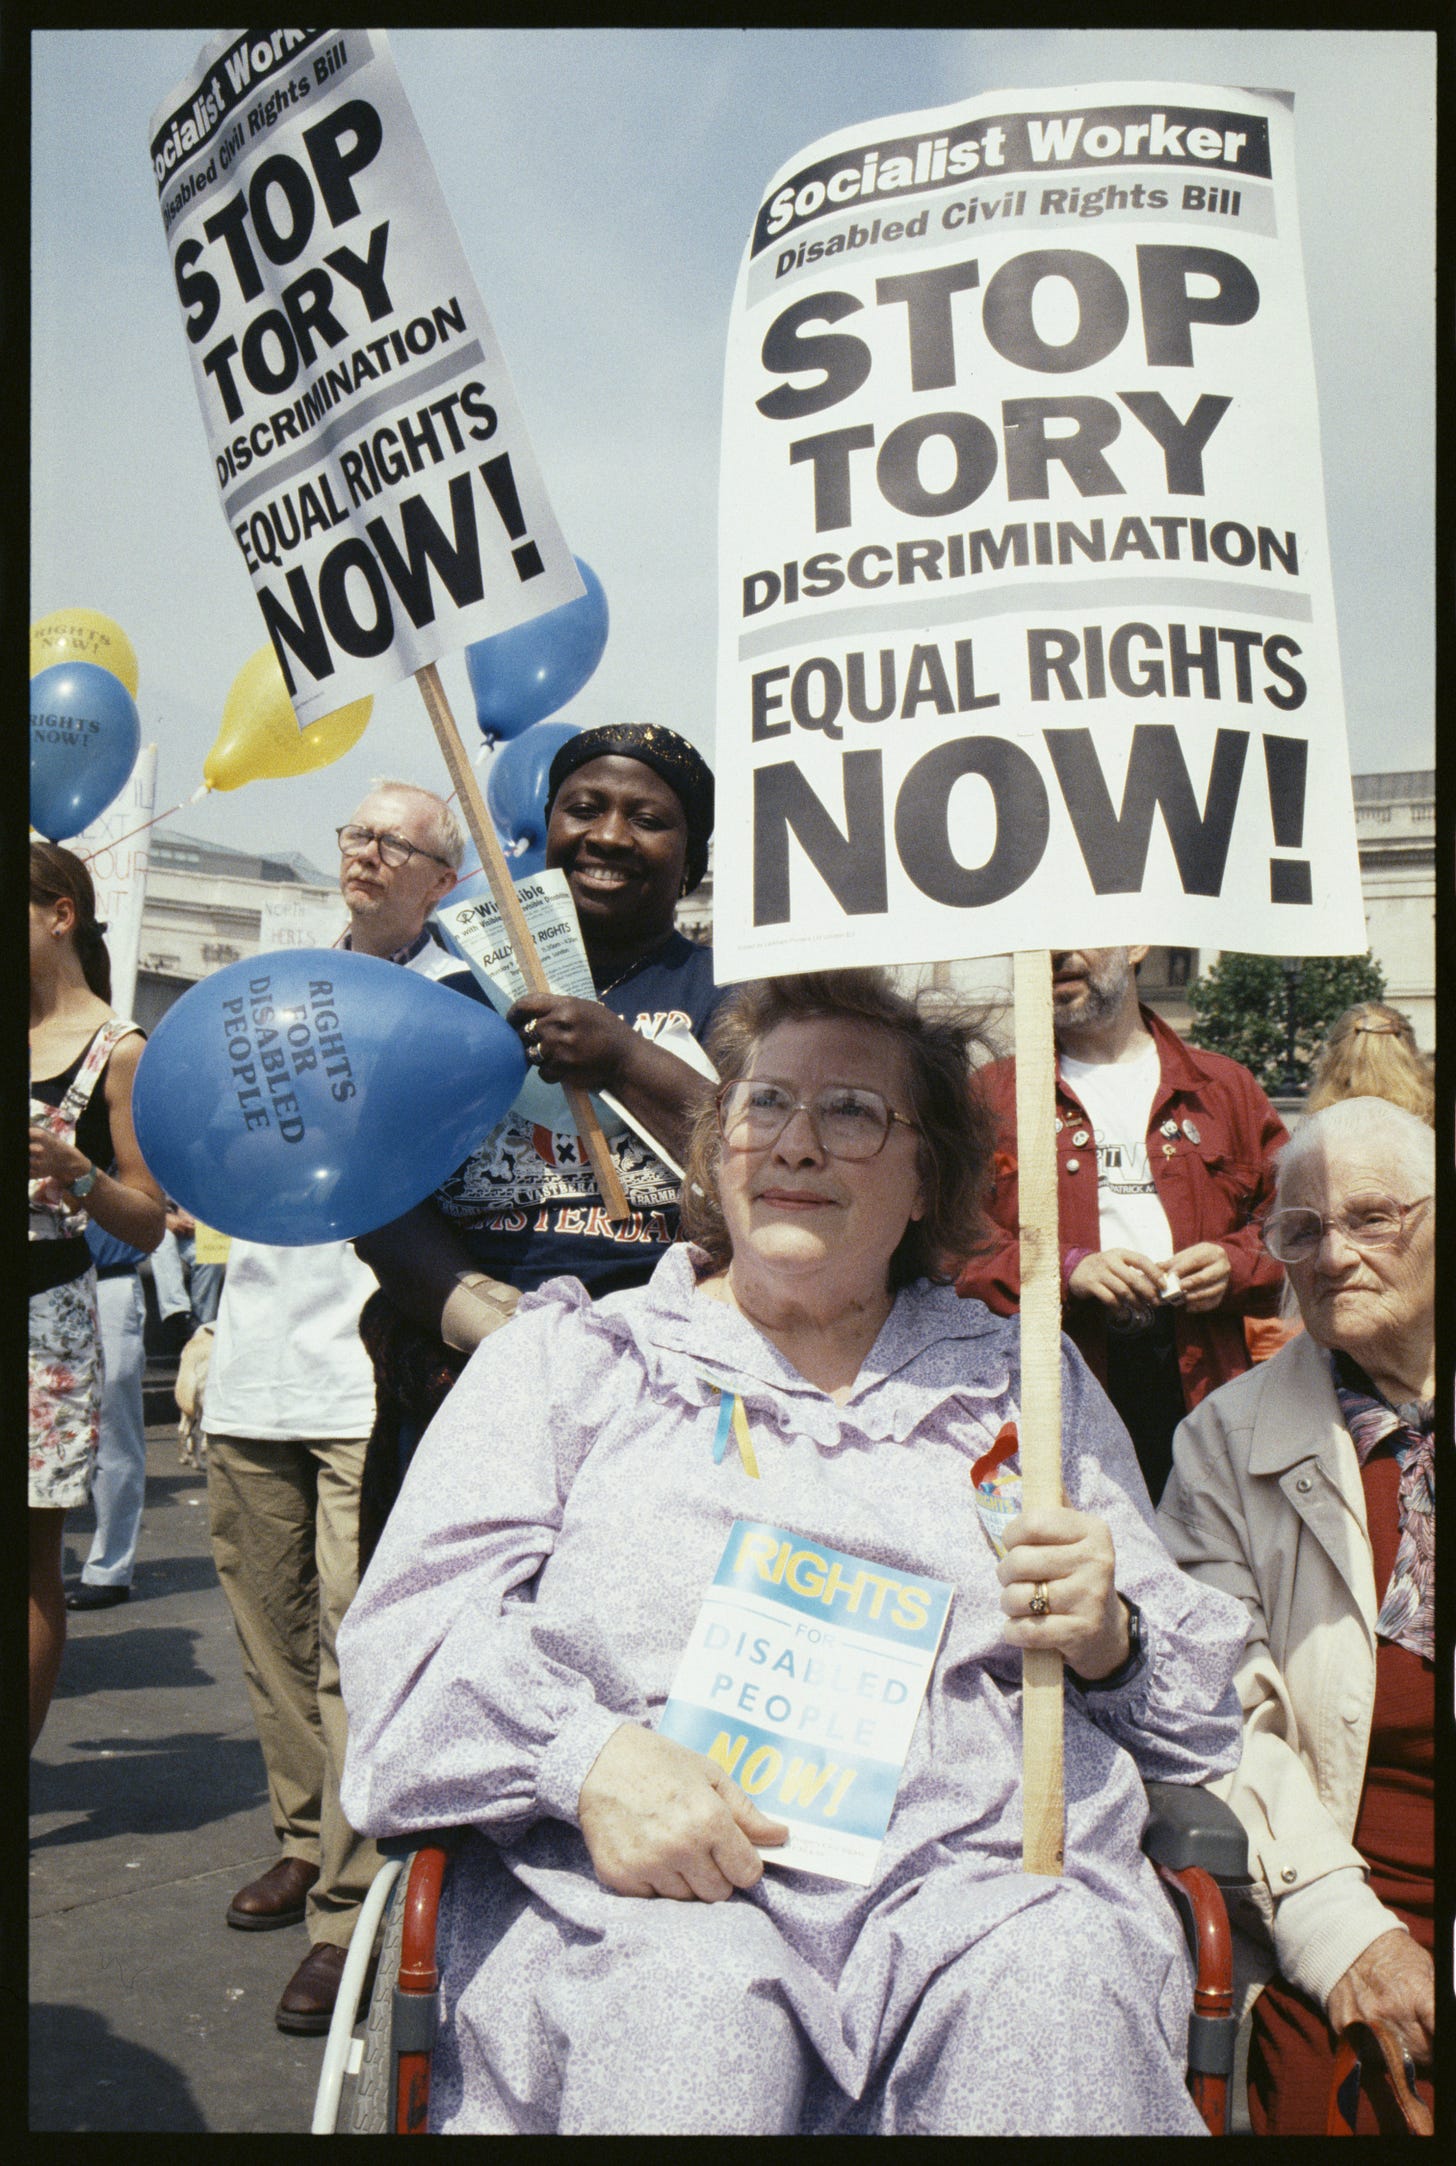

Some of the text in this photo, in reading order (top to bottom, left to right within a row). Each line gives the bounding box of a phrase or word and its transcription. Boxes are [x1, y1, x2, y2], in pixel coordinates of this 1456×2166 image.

[153, 29, 318, 183] ocialist Work
[219, 122, 246, 171] Civil
[247, 77, 311, 138] Rights
[313, 39, 348, 86] Bill
[175, 99, 383, 344] STOP
[764, 113, 1247, 236] Socialist Worker
[774, 184, 1242, 280] Disabled Civil Rights Bill
[203, 220, 394, 424] TORY
[755, 243, 1260, 421] STOP
[216, 297, 467, 490] DISCRIMINATION
[235, 381, 498, 574] EQUAL RIGHTS
[789, 390, 1235, 533] TORY
[256, 453, 546, 697] NOW!
[741, 515, 1300, 618] DISCRIMINATION
[35, 624, 111, 646] RIGHTS
[751, 621, 1309, 743] EQUAL RIGHTS
[34, 730, 92, 747] NOW!
[752, 723, 1314, 928] NOW!
[483, 944, 514, 968] RALLY
[538, 922, 572, 944] RIGHTS
[222, 996, 271, 1131] PEOPLE
[249, 975, 306, 1144] DISABLED
[286, 1003, 318, 1080] FOR
[308, 978, 357, 1103] RIGHTS
[462, 1204, 688, 1244] MSTERDA
[525, 1181, 598, 1201] VASTBERA
[732, 1531, 933, 1631] RIGHTS
[794, 1622, 836, 1650] FOR
[702, 1620, 910, 1706] DISABLED
[709, 1672, 877, 1748] PEOPLE
[706, 1731, 858, 1818] NOW!
